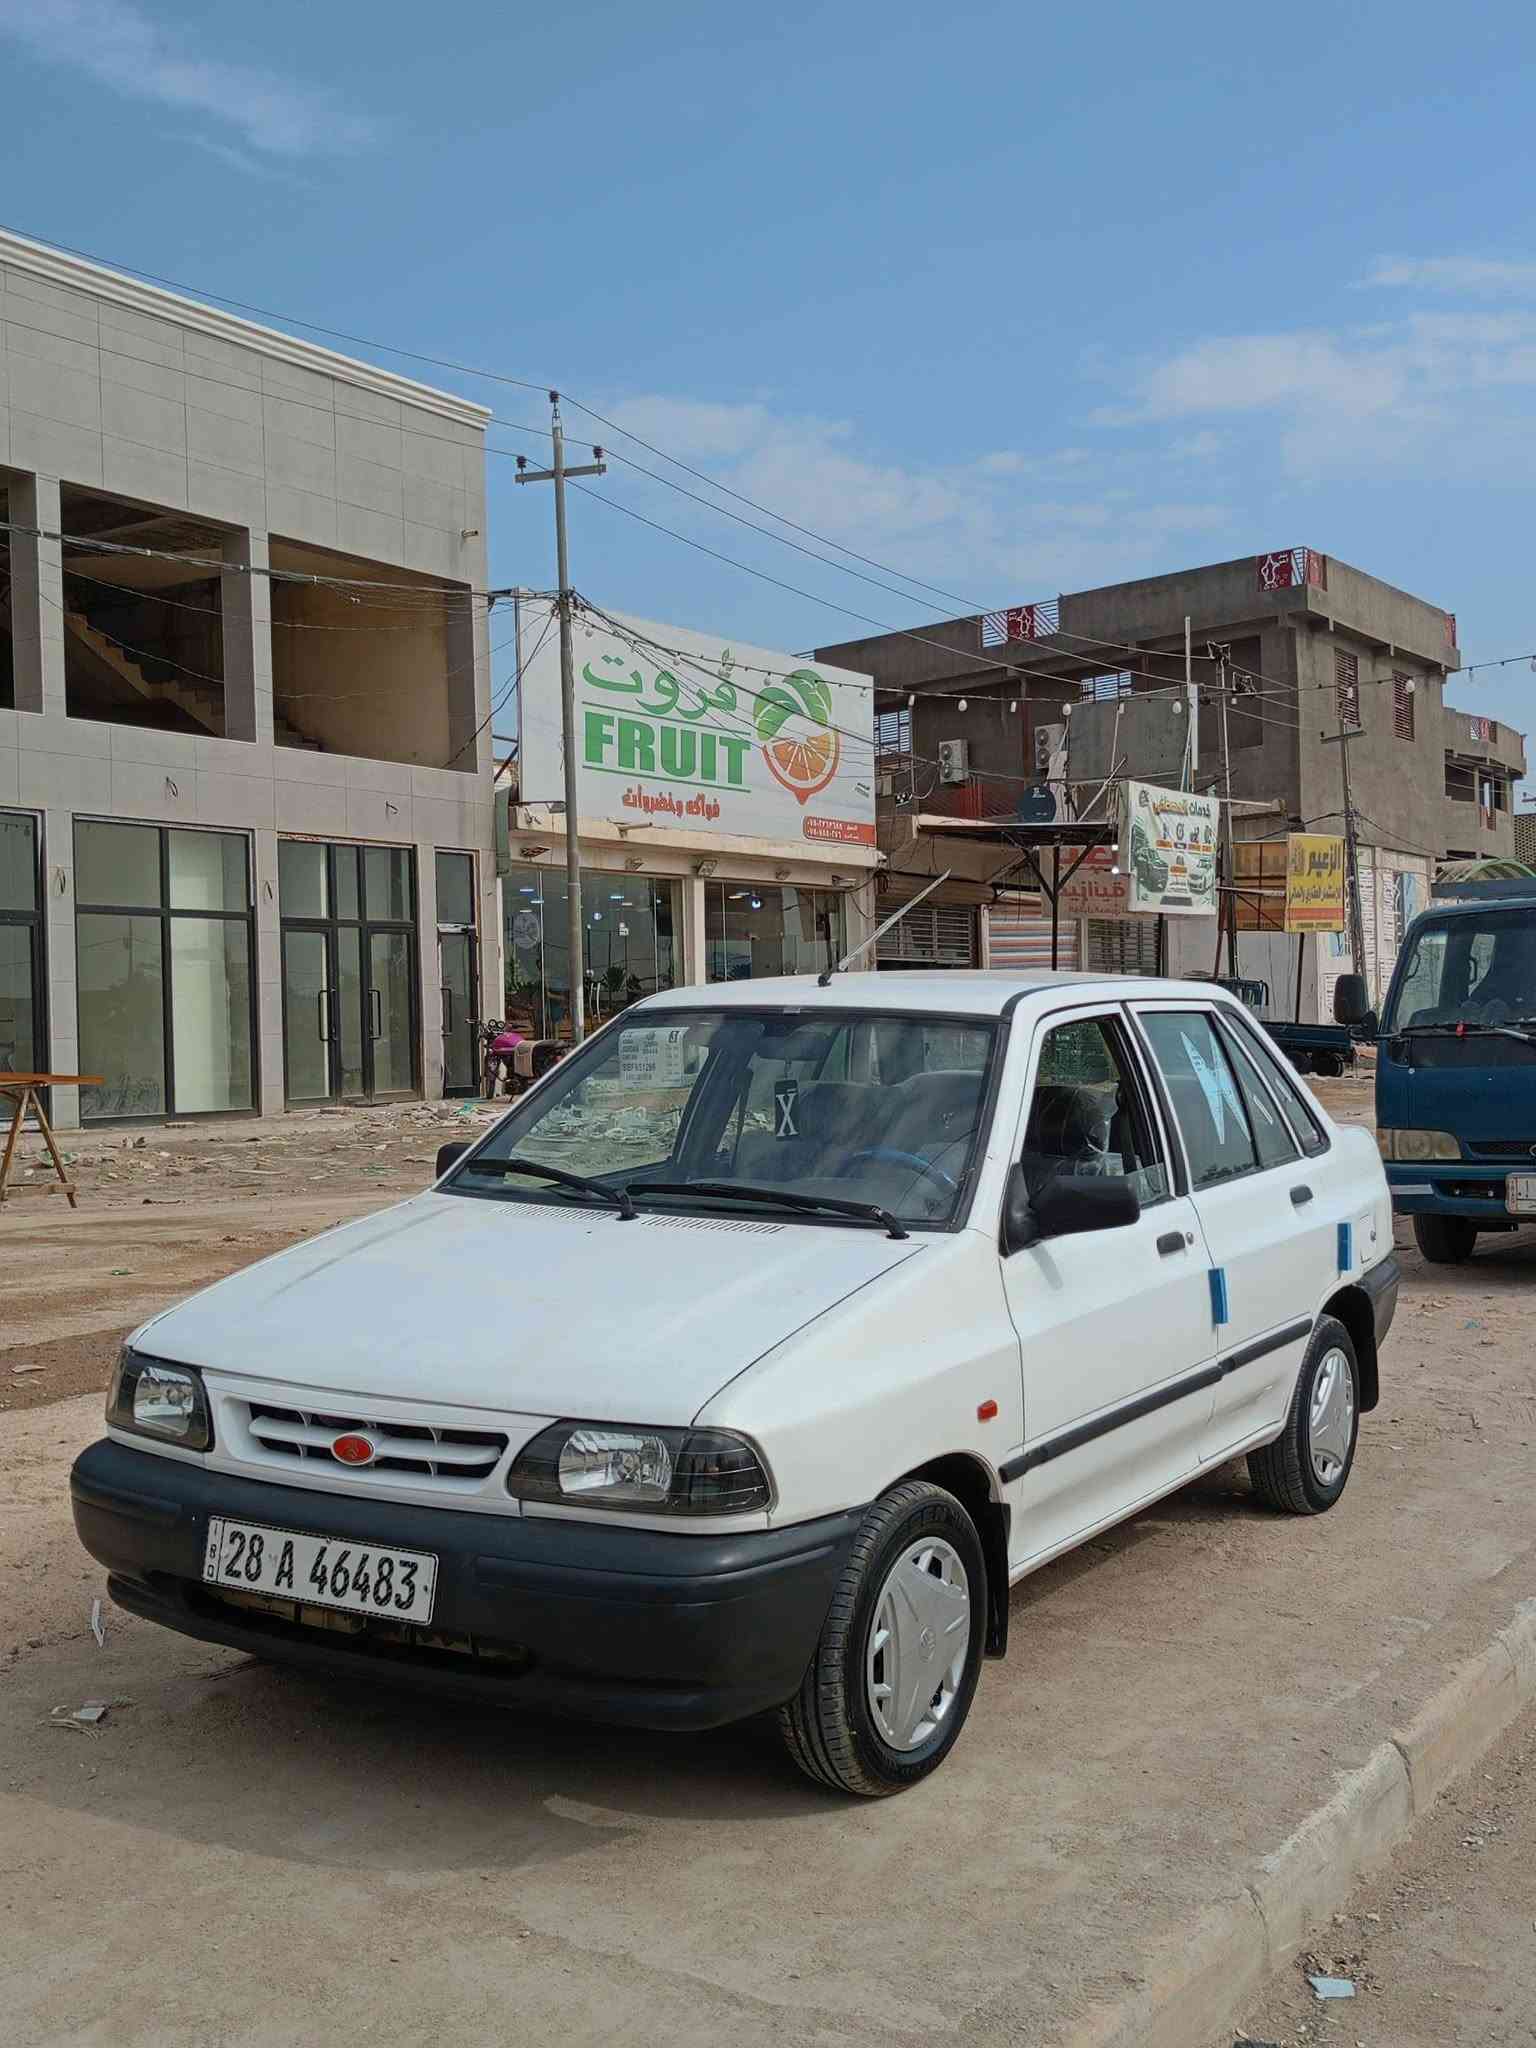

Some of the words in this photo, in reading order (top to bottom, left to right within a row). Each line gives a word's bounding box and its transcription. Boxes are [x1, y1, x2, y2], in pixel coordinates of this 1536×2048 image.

[584, 711, 751, 786] FRUIT
[225, 1530, 265, 1582] 28
[275, 1539, 295, 1589] A
[309, 1546, 419, 1610] 46483
